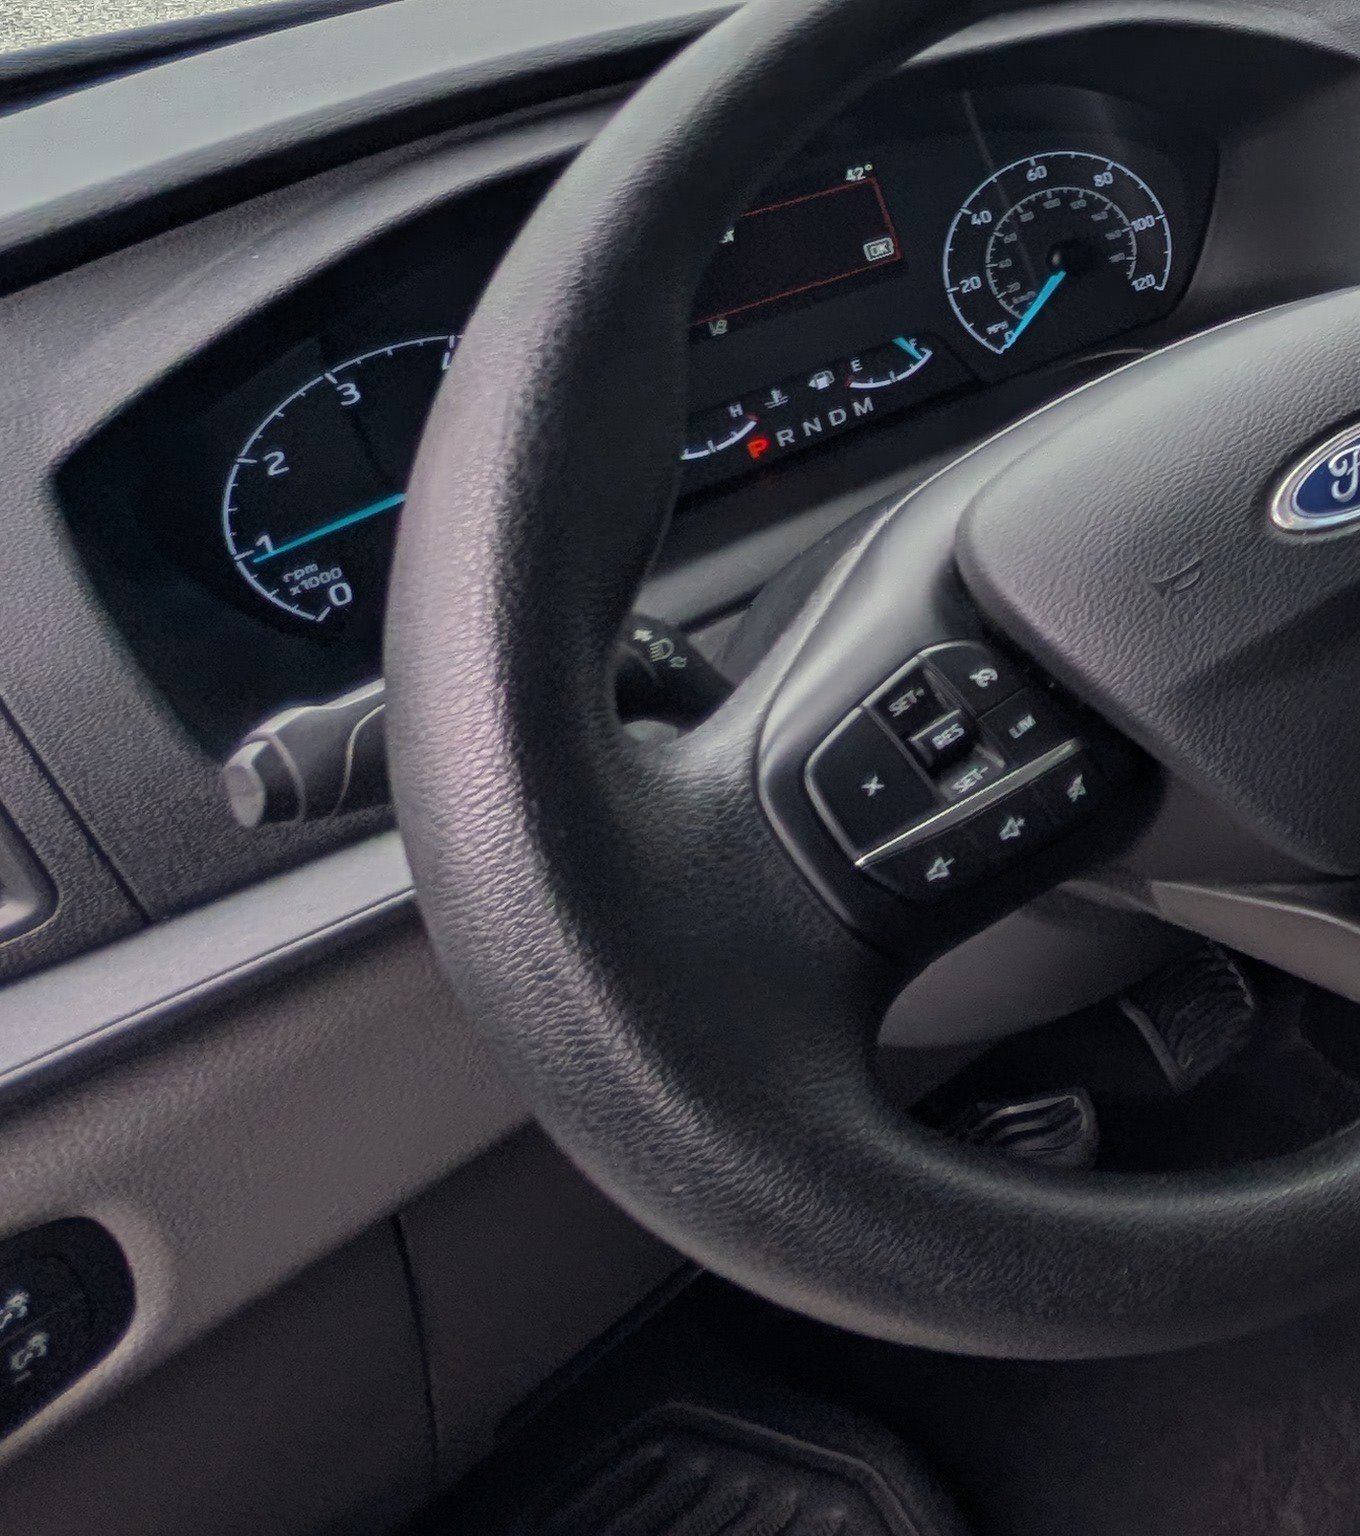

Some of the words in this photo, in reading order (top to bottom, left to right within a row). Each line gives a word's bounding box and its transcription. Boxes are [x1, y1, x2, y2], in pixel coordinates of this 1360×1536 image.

[845, 163, 874, 182] 42°
[1026, 165, 1049, 182] 60
[1093, 171, 1115, 188] 80
[970, 209, 994, 227] 40
[1131, 214, 1157, 233] 100
[867, 240, 892, 258] OK
[959, 275, 983, 295] 20
[1131, 273, 1157, 293] 120
[850, 358, 864, 373] E
[336, 381, 362, 406] 3
[728, 403, 744, 419] H
[747, 438, 770, 460] P
[775, 428, 796, 448] R
[801, 416, 823, 437] N
[827, 407, 848, 428] D
[852, 395, 875, 417] M
[262, 450, 290, 478] 2
[255, 534, 274, 555] 1
[282, 562, 319, 583] rpm
[289, 566, 343, 596] x1000
[328, 581, 353, 607] 0
[931, 722, 966, 752] RES
[1008, 714, 1038, 740] LIM
